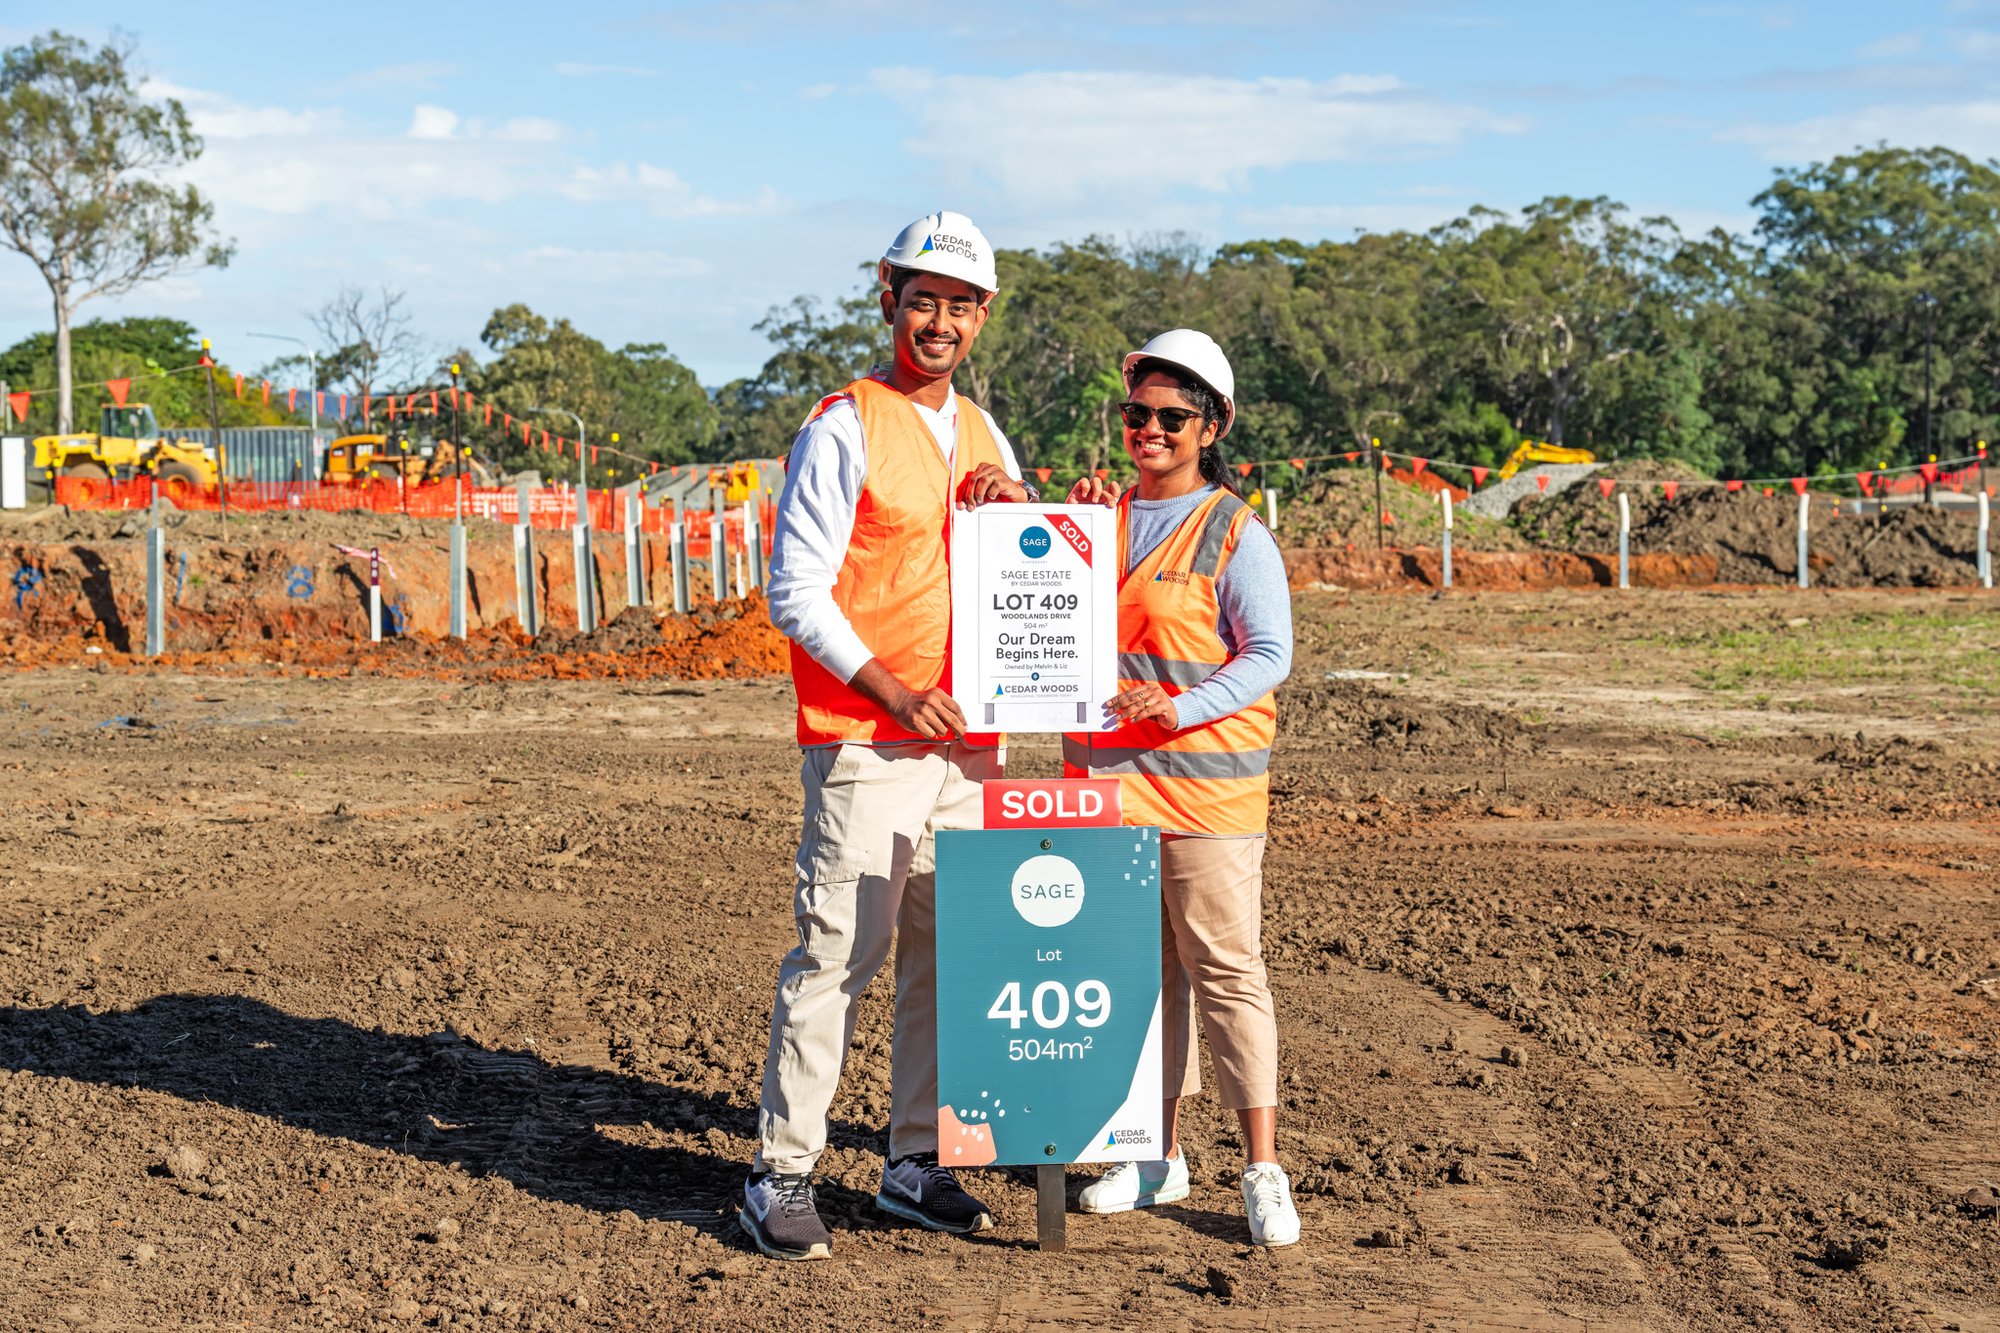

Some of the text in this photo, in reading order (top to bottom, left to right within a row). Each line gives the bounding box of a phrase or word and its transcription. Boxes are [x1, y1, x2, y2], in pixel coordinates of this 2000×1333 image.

[933, 233, 972, 250] CEDAR
[934, 242, 978, 262] WOODS
[1022, 538, 1048, 546] SAGE
[1059, 520, 1088, 552] SOLD
[1001, 570, 1072, 580] SAGE ESTATE
[1162, 576, 1189, 586] WOODS
[994, 594, 1078, 610] LOT 409
[998, 632, 1075, 645] Our Dream
[996, 648, 1078, 662] Begins Here.
[1001, 789, 1103, 820] SOLD
[1020, 884, 1076, 899] SAGE
[1036, 948, 1062, 962] Lot
[986, 980, 1112, 1030] 409
